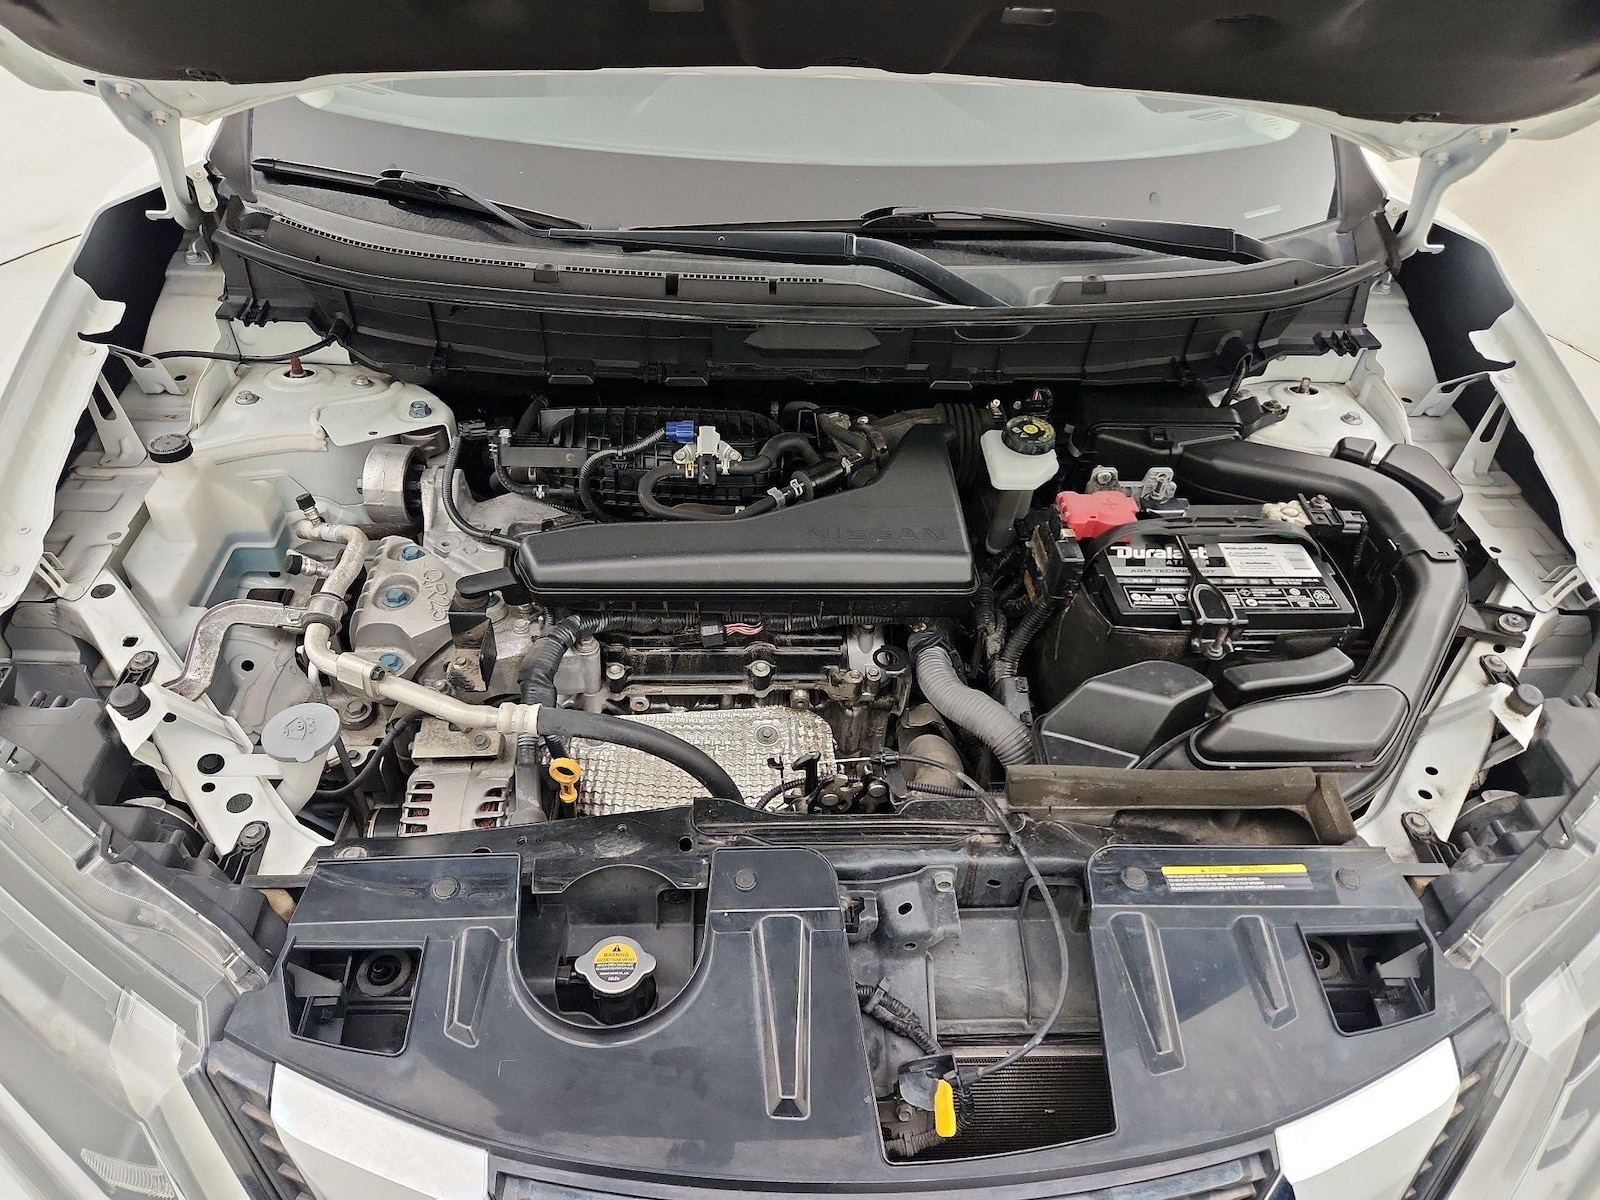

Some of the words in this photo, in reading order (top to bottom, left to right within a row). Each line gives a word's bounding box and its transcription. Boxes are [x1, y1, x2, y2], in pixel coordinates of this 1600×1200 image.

[805, 525, 948, 543] NISSAN
[1110, 546, 1209, 559] Duralast
[422, 568, 450, 621] QR25
